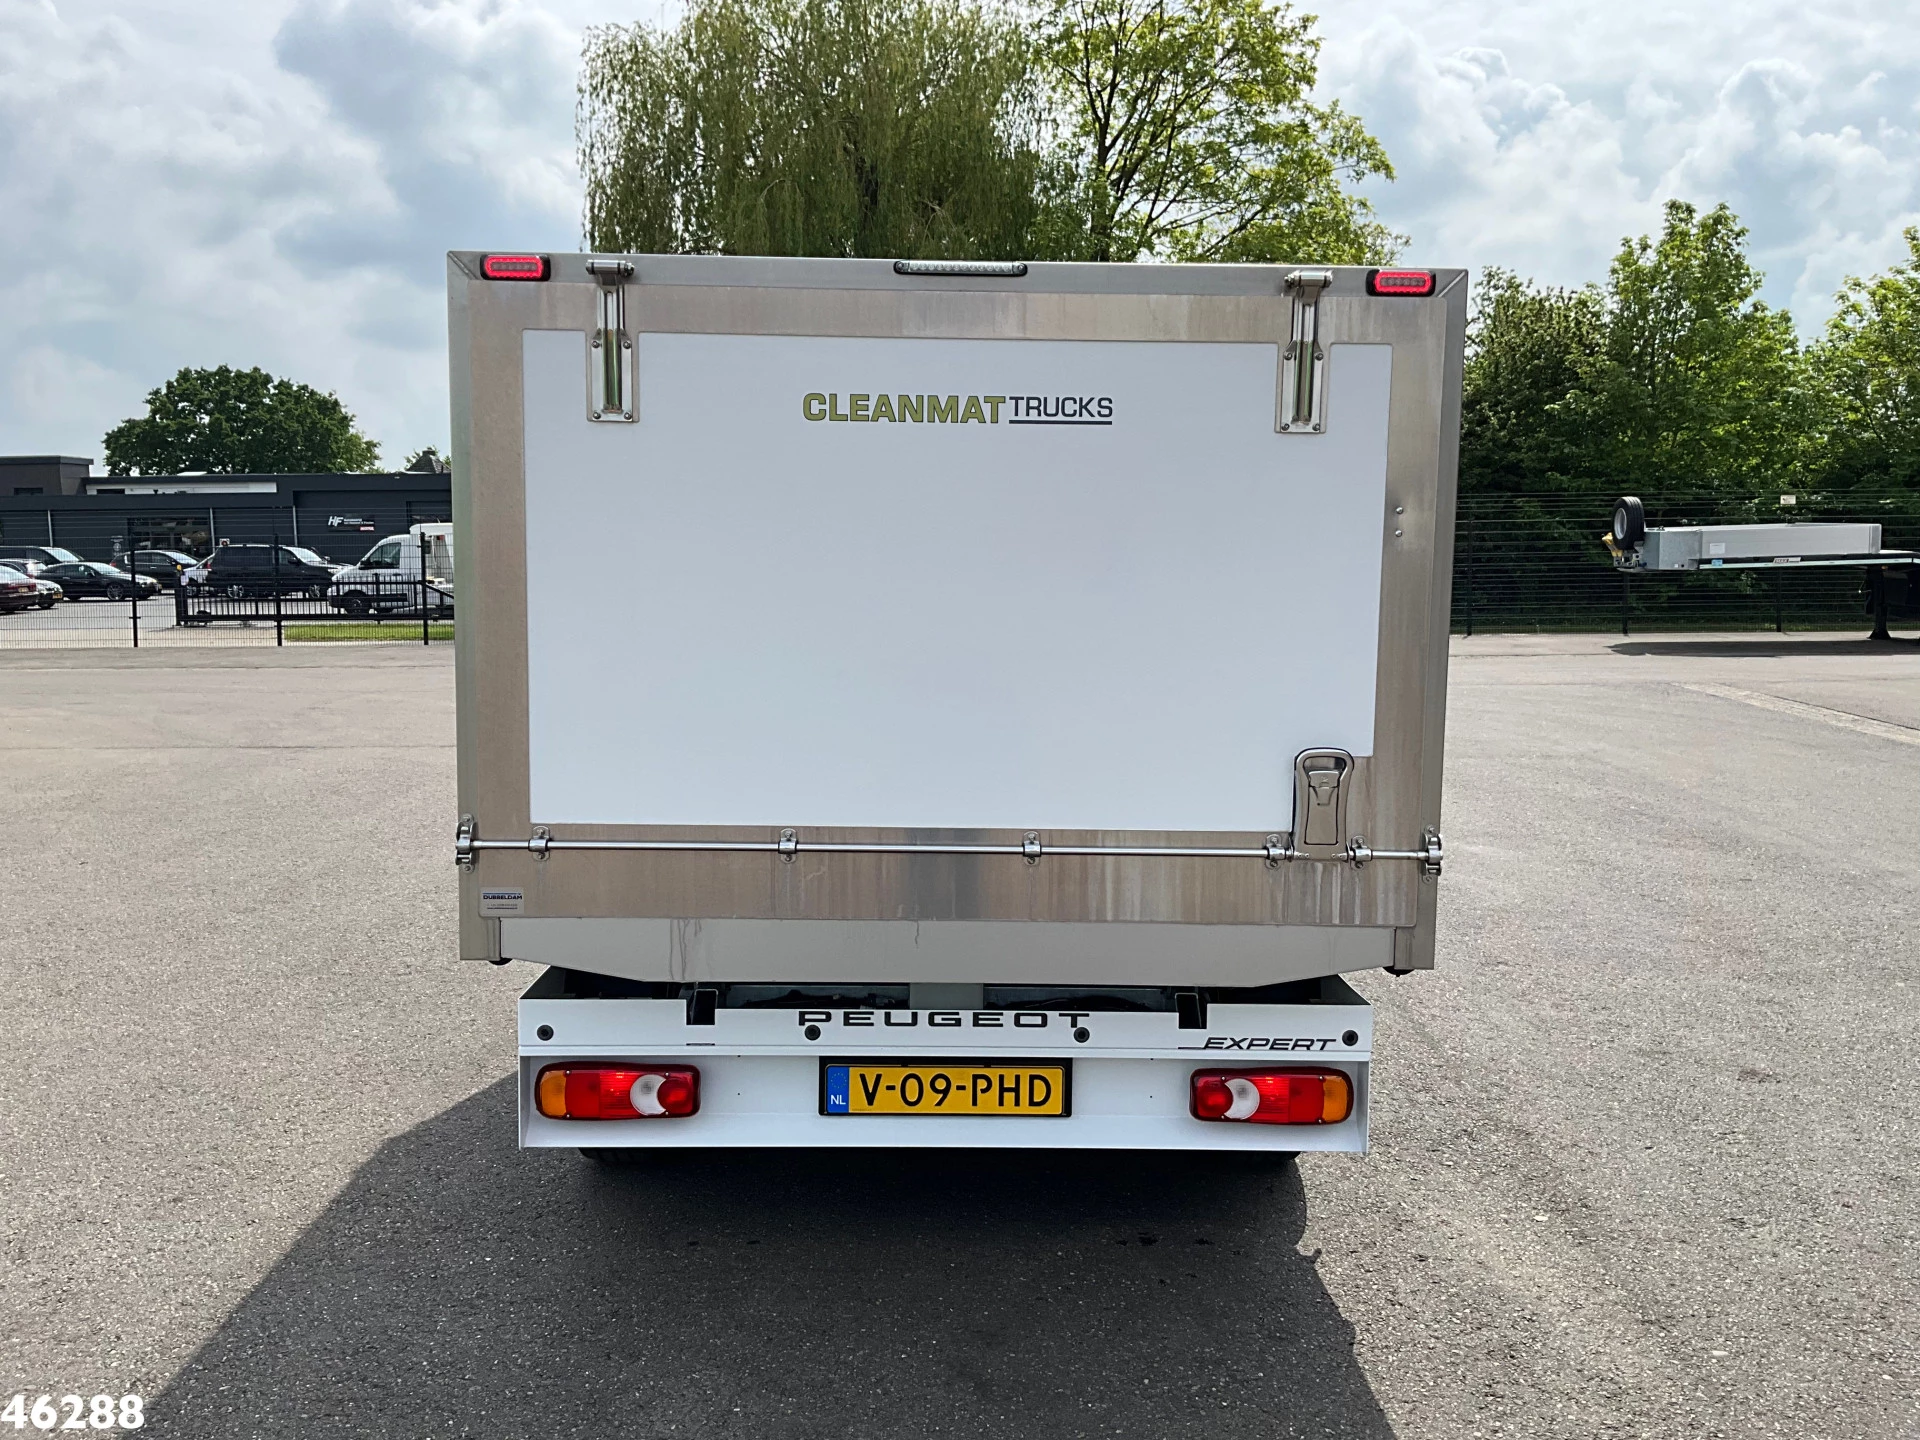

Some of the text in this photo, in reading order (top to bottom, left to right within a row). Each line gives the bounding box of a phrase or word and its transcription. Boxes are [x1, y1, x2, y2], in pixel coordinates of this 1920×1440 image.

[802, 392, 1113, 424] CLEANMAT TRUCKS
[798, 1011, 1090, 1029] PEUGEOT
[1203, 1037, 1337, 1051] EXPERT
[859, 1073, 1052, 1107] V-09-PHD
[830, 1094, 846, 1106] NL
